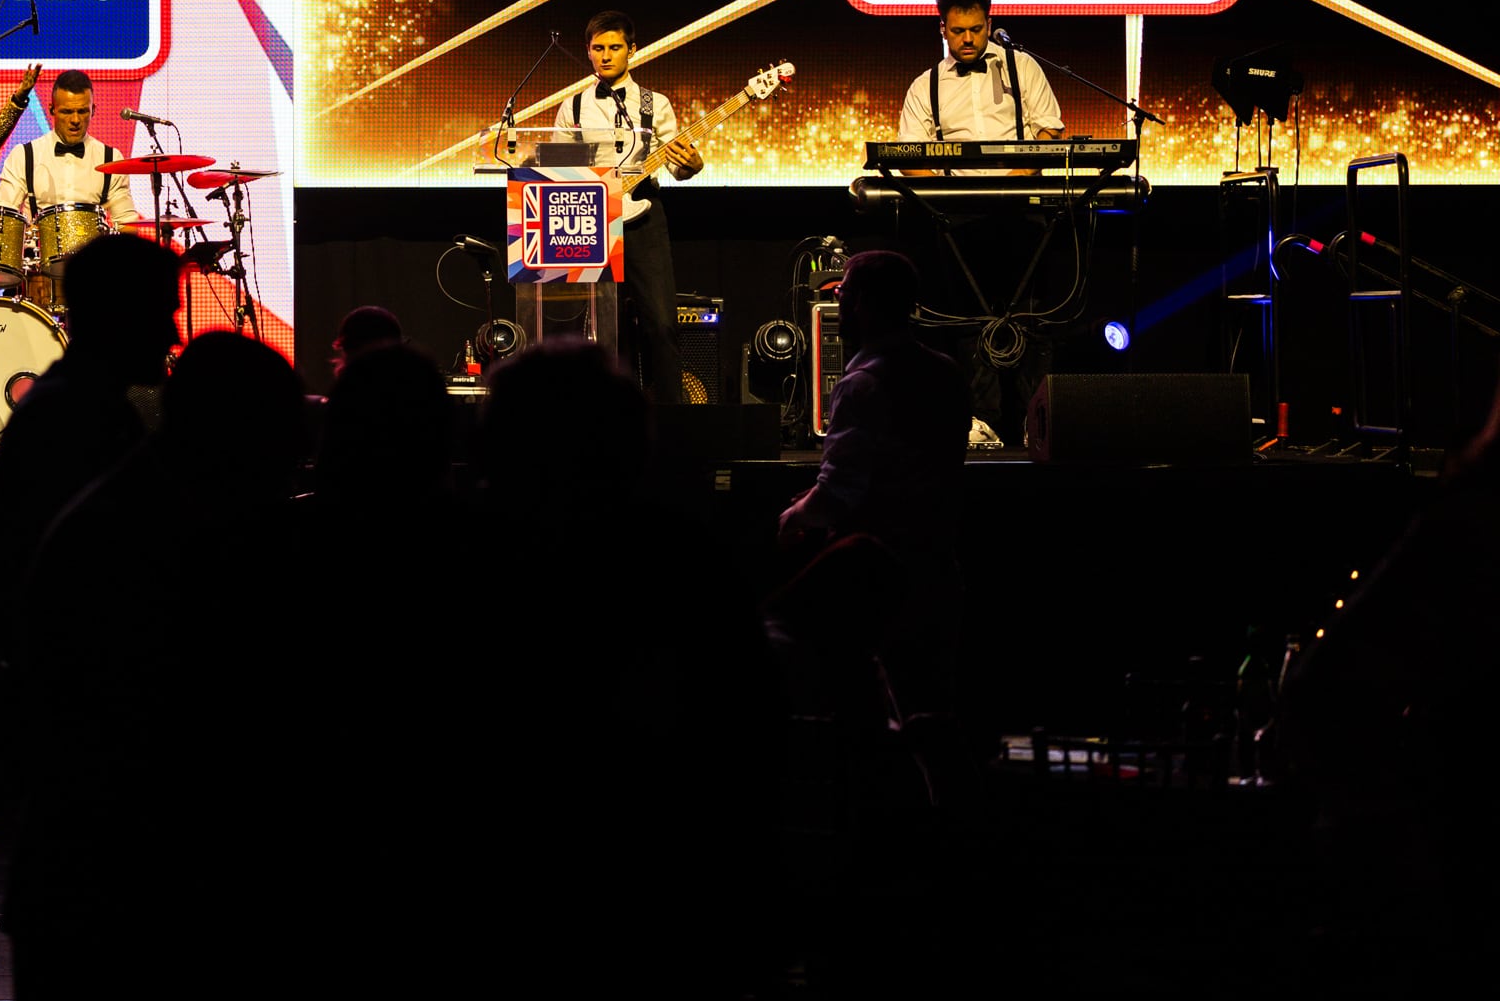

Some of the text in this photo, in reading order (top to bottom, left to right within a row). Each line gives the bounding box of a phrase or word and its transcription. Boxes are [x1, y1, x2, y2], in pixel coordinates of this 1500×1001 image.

[1248, 67, 1277, 78] SHURE
[897, 144, 922, 153] KORG
[925, 143, 962, 156] KORG
[548, 191, 597, 204] GREAT
[548, 205, 597, 216] BRITISH
[548, 216, 597, 235] PUB
[549, 236, 598, 246] AWARDS
[555, 246, 591, 258] 2025
